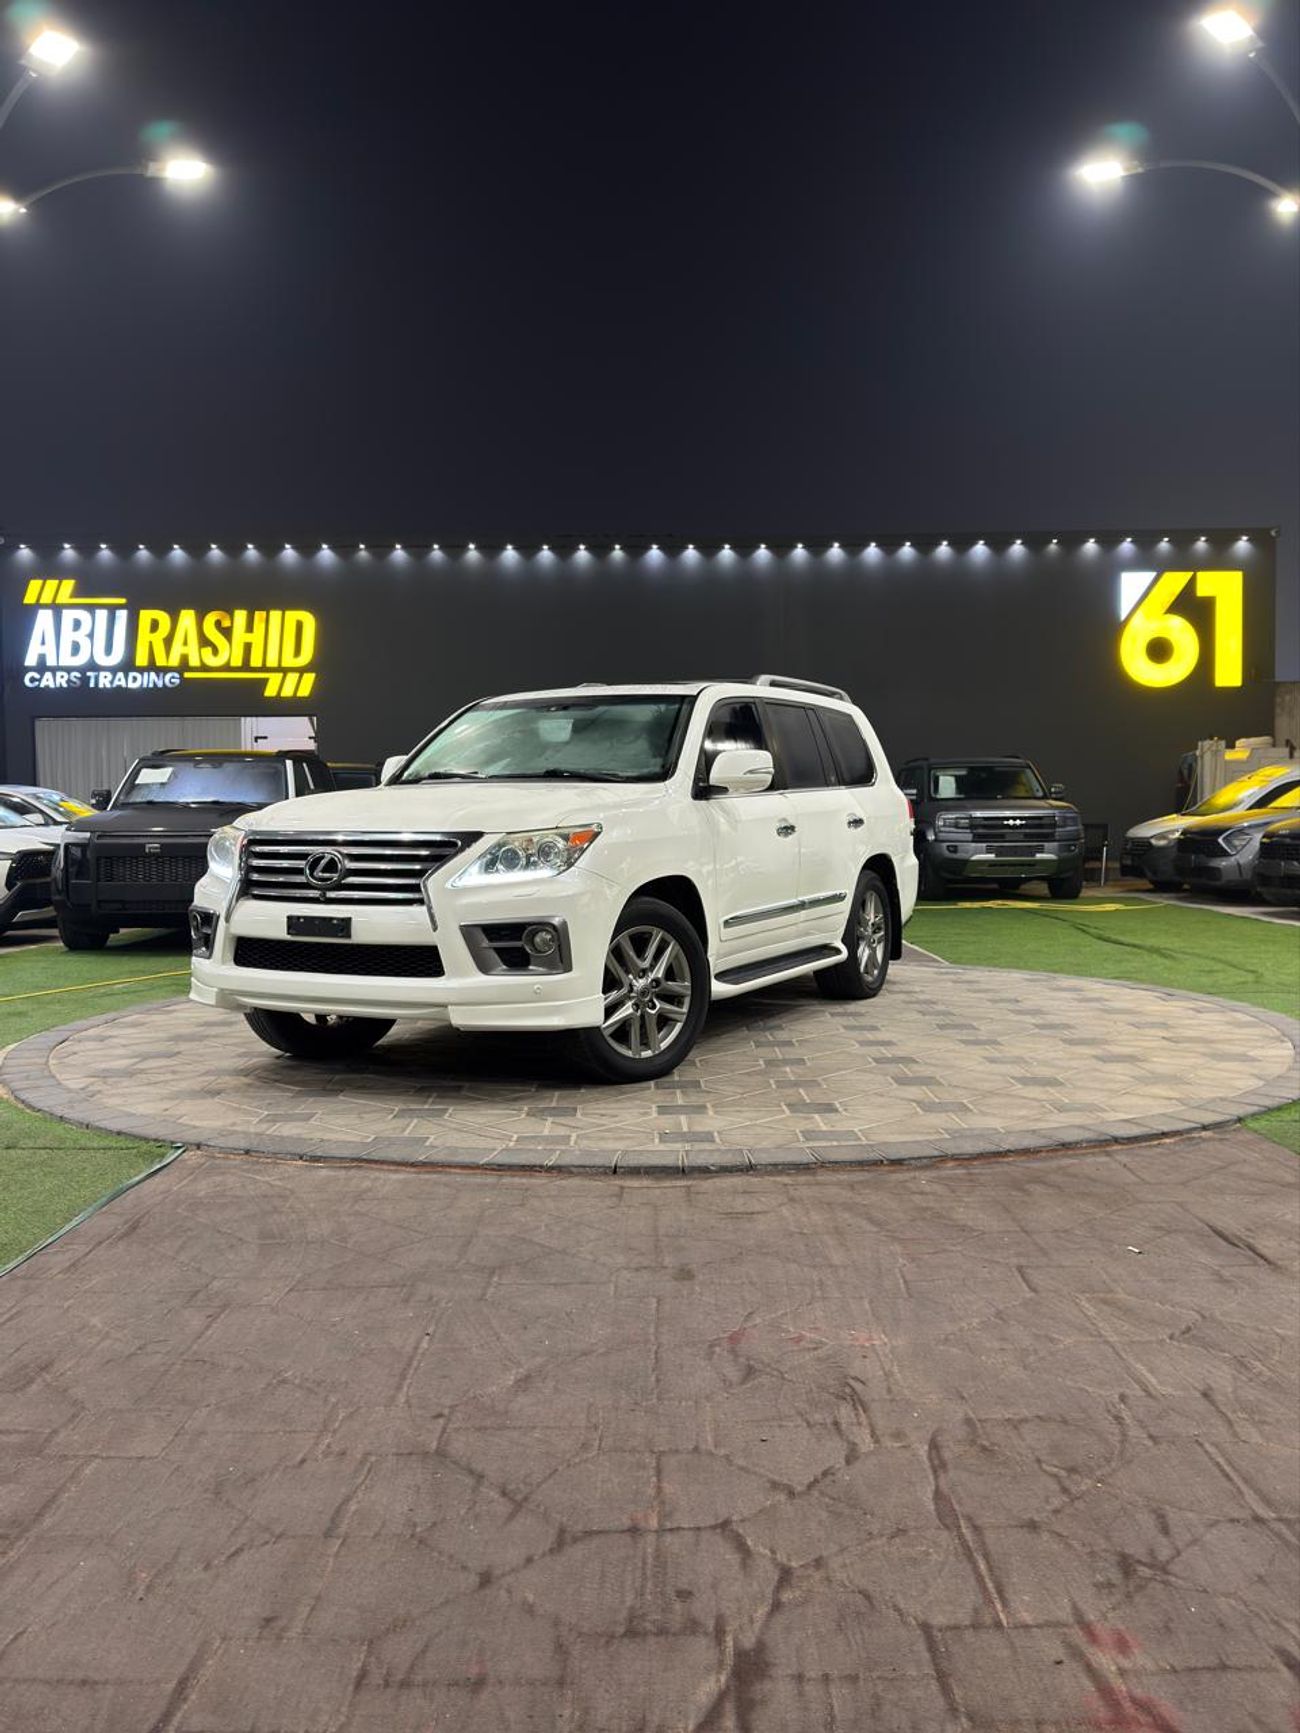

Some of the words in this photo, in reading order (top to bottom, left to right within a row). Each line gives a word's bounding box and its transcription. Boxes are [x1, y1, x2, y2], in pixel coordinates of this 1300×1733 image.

[24, 609, 127, 667] ABU
[135, 609, 316, 667] RASHID
[1120, 571, 1243, 688] 61
[24, 671, 81, 688] CARS
[87, 671, 180, 688] TRADING
